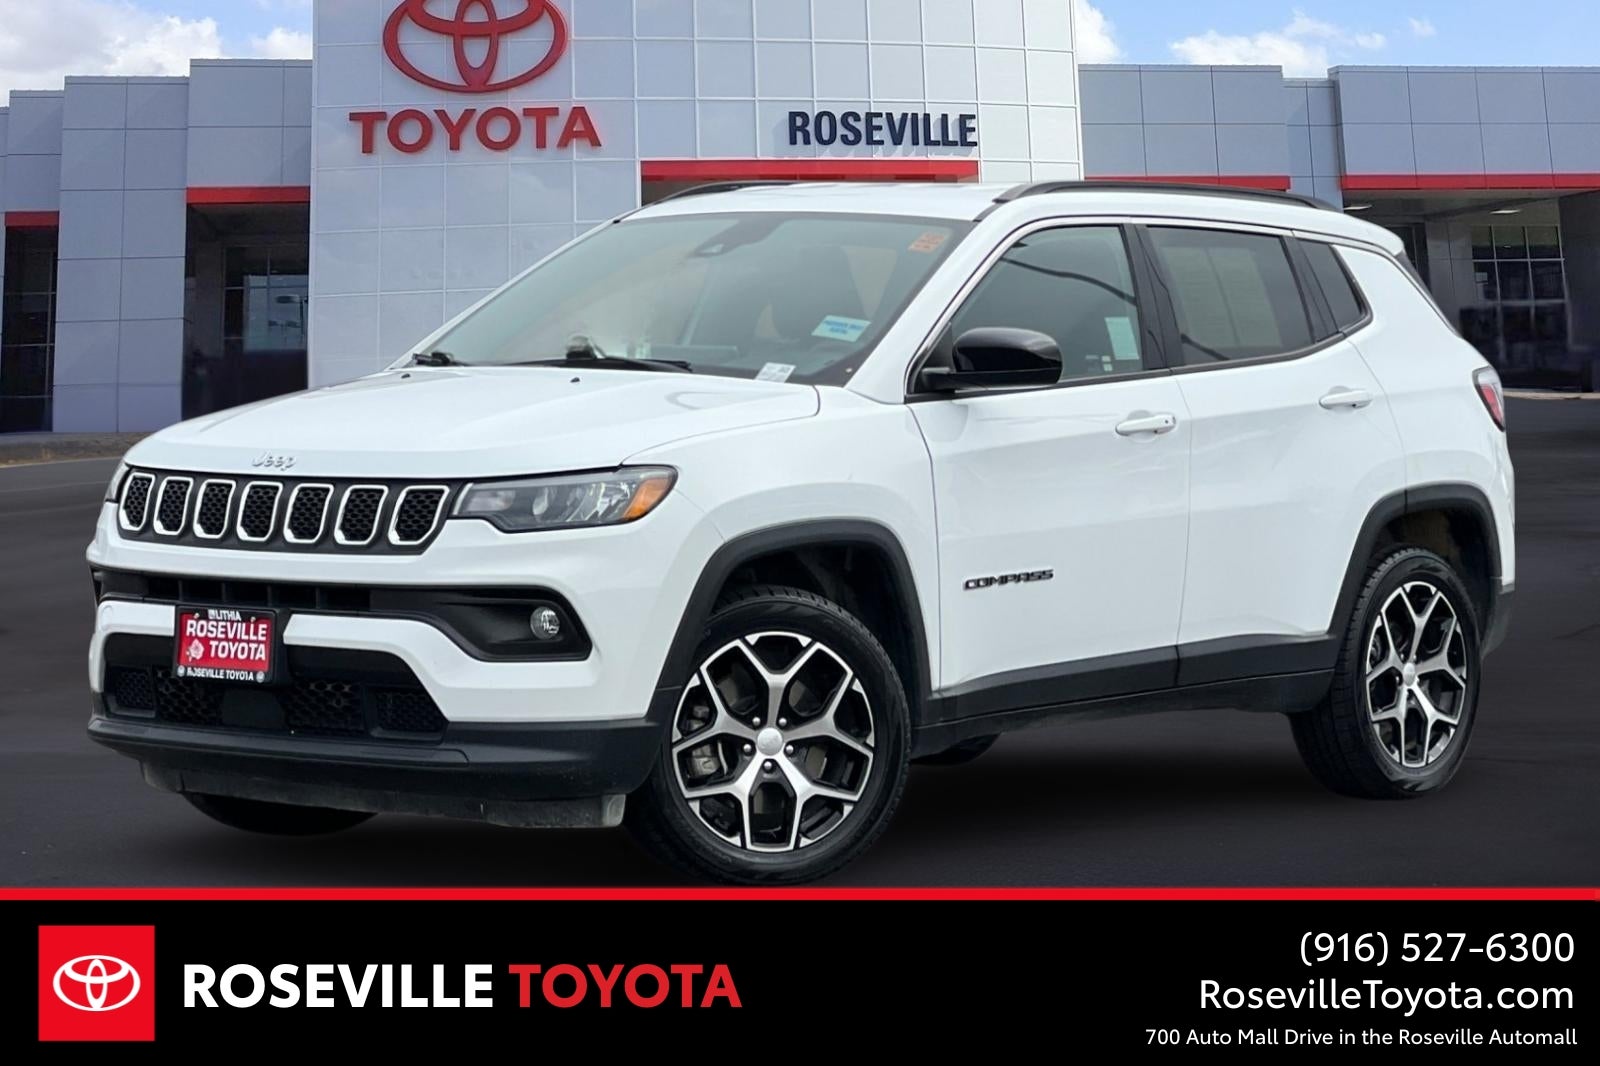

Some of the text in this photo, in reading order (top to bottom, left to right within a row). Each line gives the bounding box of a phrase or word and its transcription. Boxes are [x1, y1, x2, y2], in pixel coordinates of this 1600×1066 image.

[349, 106, 602, 154] TOYOTA
[788, 110, 978, 147] ROSEVILLE
[251, 451, 297, 472] Jeep
[963, 569, 1054, 591] COMPASS
[215, 609, 242, 622] LITHIA
[186, 619, 268, 641] ROSEVILLE
[209, 640, 266, 661] TOYOTA
